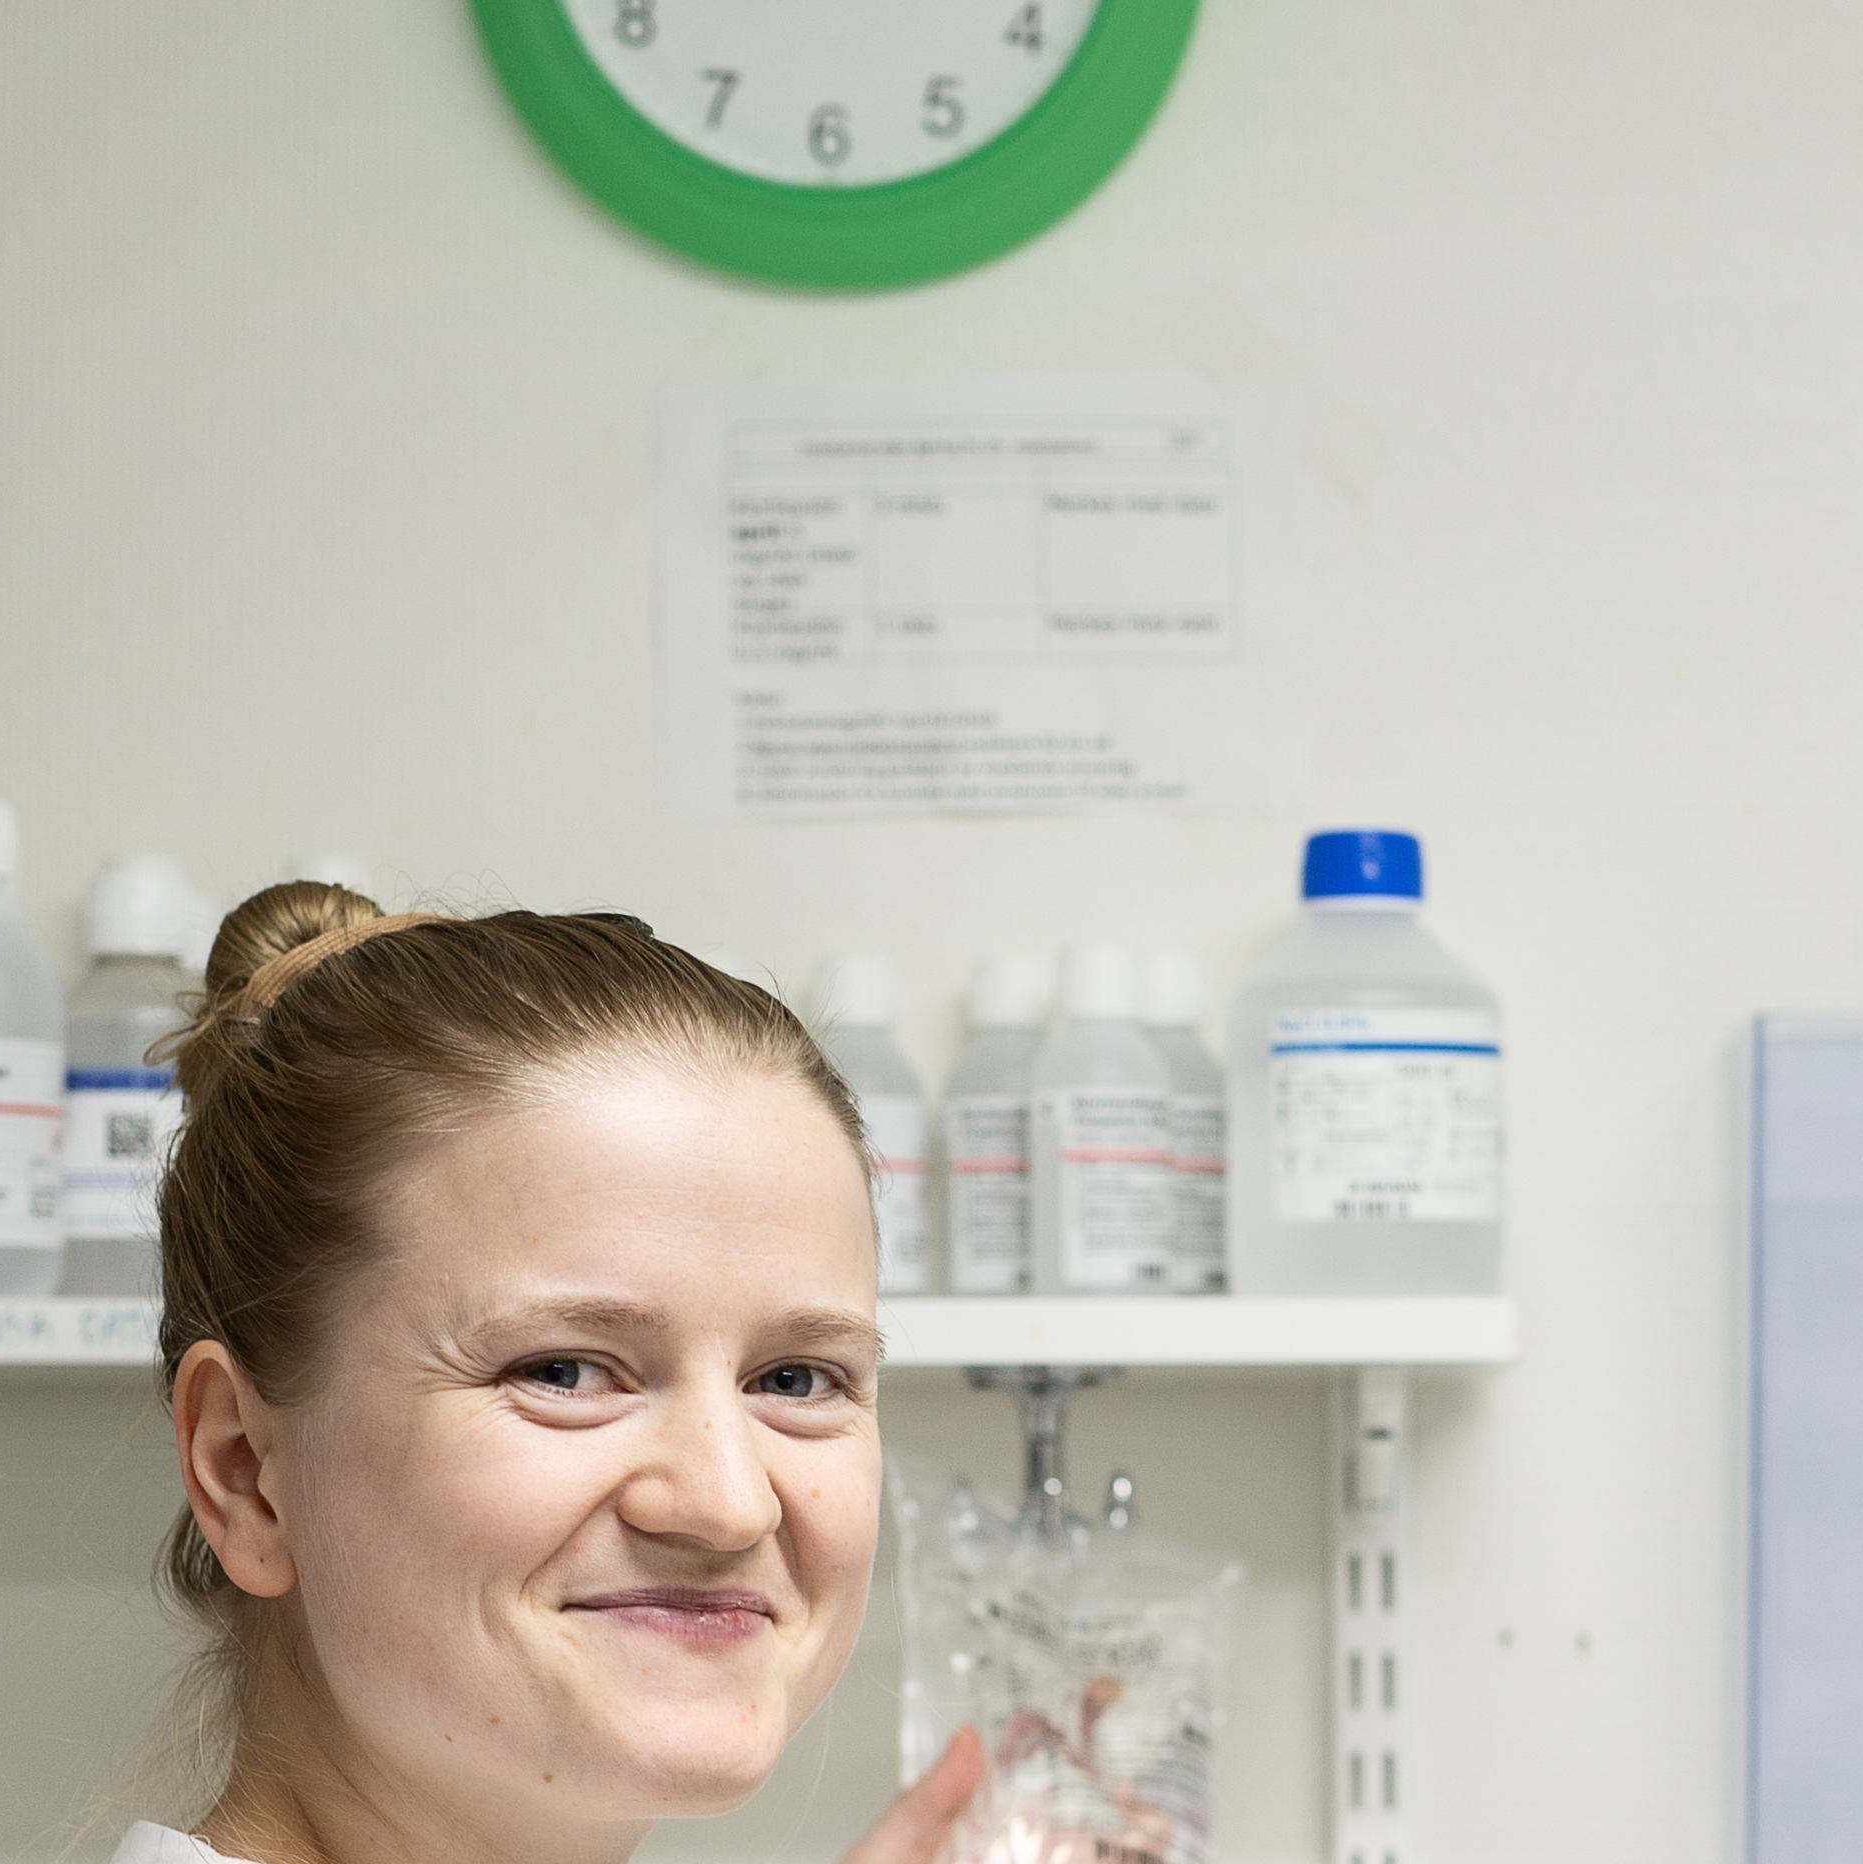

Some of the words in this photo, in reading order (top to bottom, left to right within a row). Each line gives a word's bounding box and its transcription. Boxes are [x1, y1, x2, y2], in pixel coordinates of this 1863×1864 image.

[614, 0, 657, 50] 8
[1004, 0, 1043, 54] 4
[699, 67, 740, 132] 7
[921, 74, 965, 138] 5
[807, 102, 853, 167] 6
